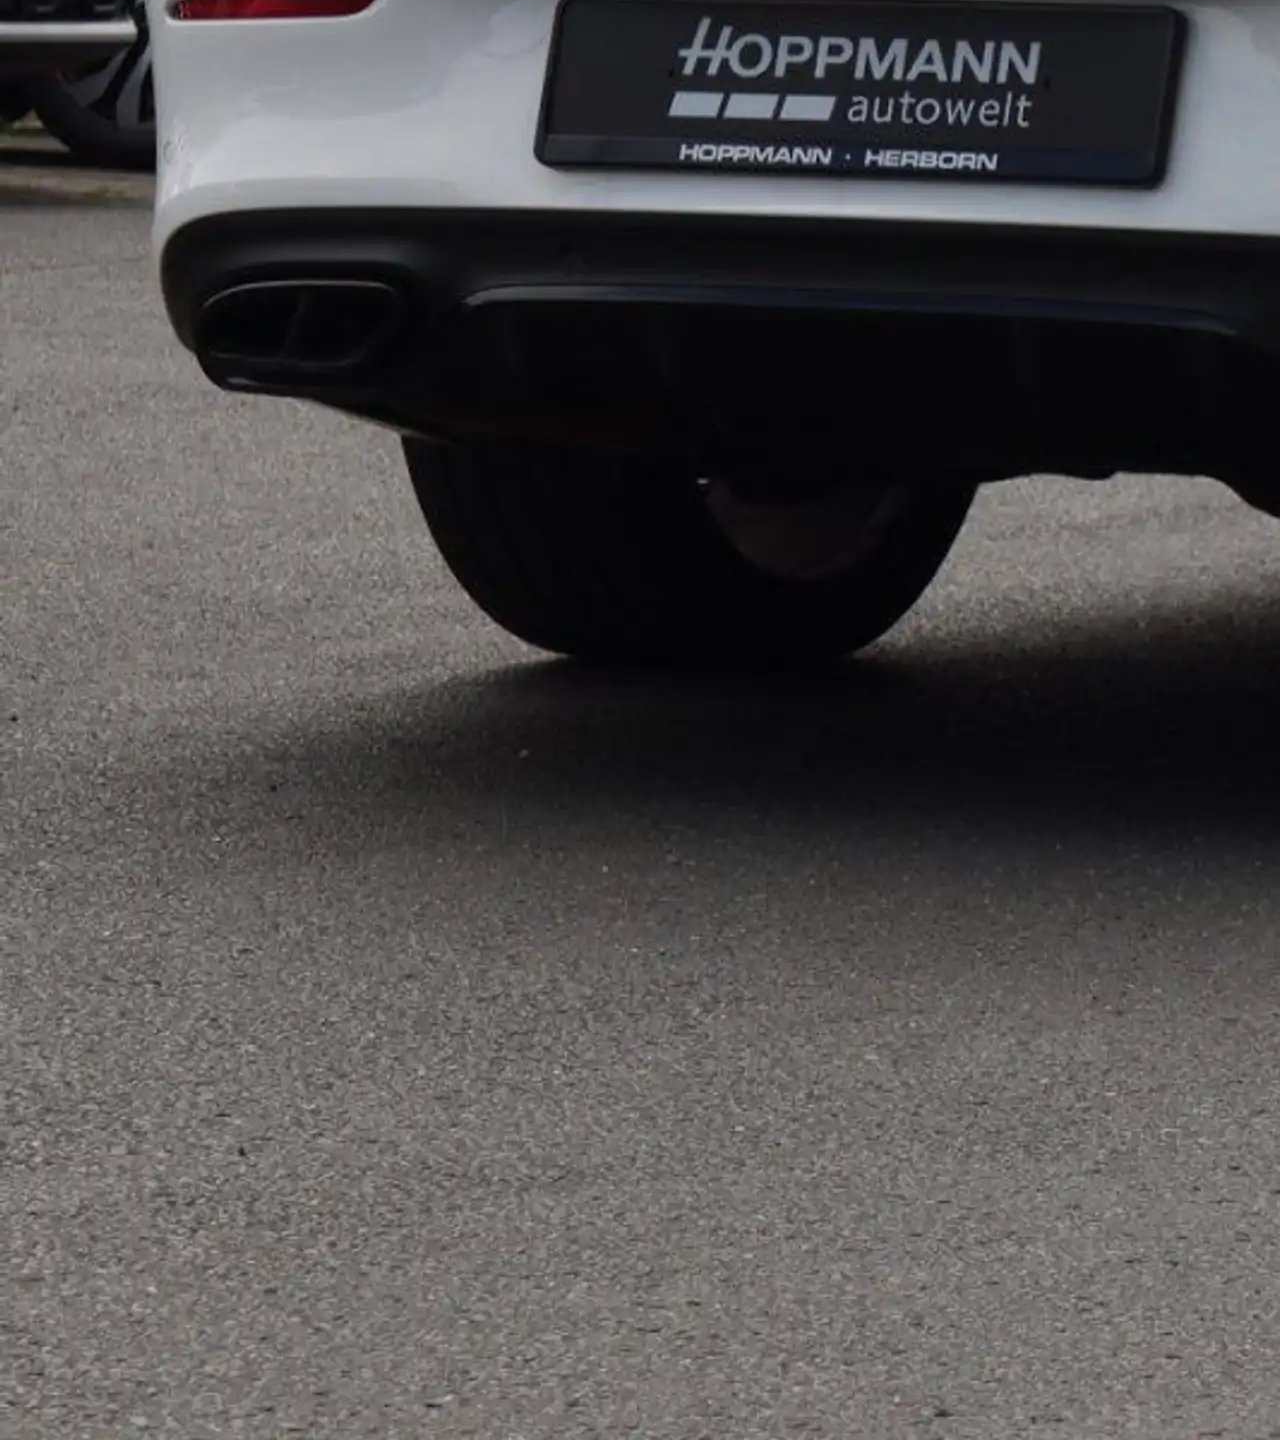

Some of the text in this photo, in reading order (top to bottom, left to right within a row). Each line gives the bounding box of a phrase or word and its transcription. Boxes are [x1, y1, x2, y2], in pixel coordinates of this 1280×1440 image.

[678, 17, 1041, 85] HOPPMANN
[847, 92, 1033, 127] autowelt
[679, 143, 999, 171] HOPPMANN HERBORN
